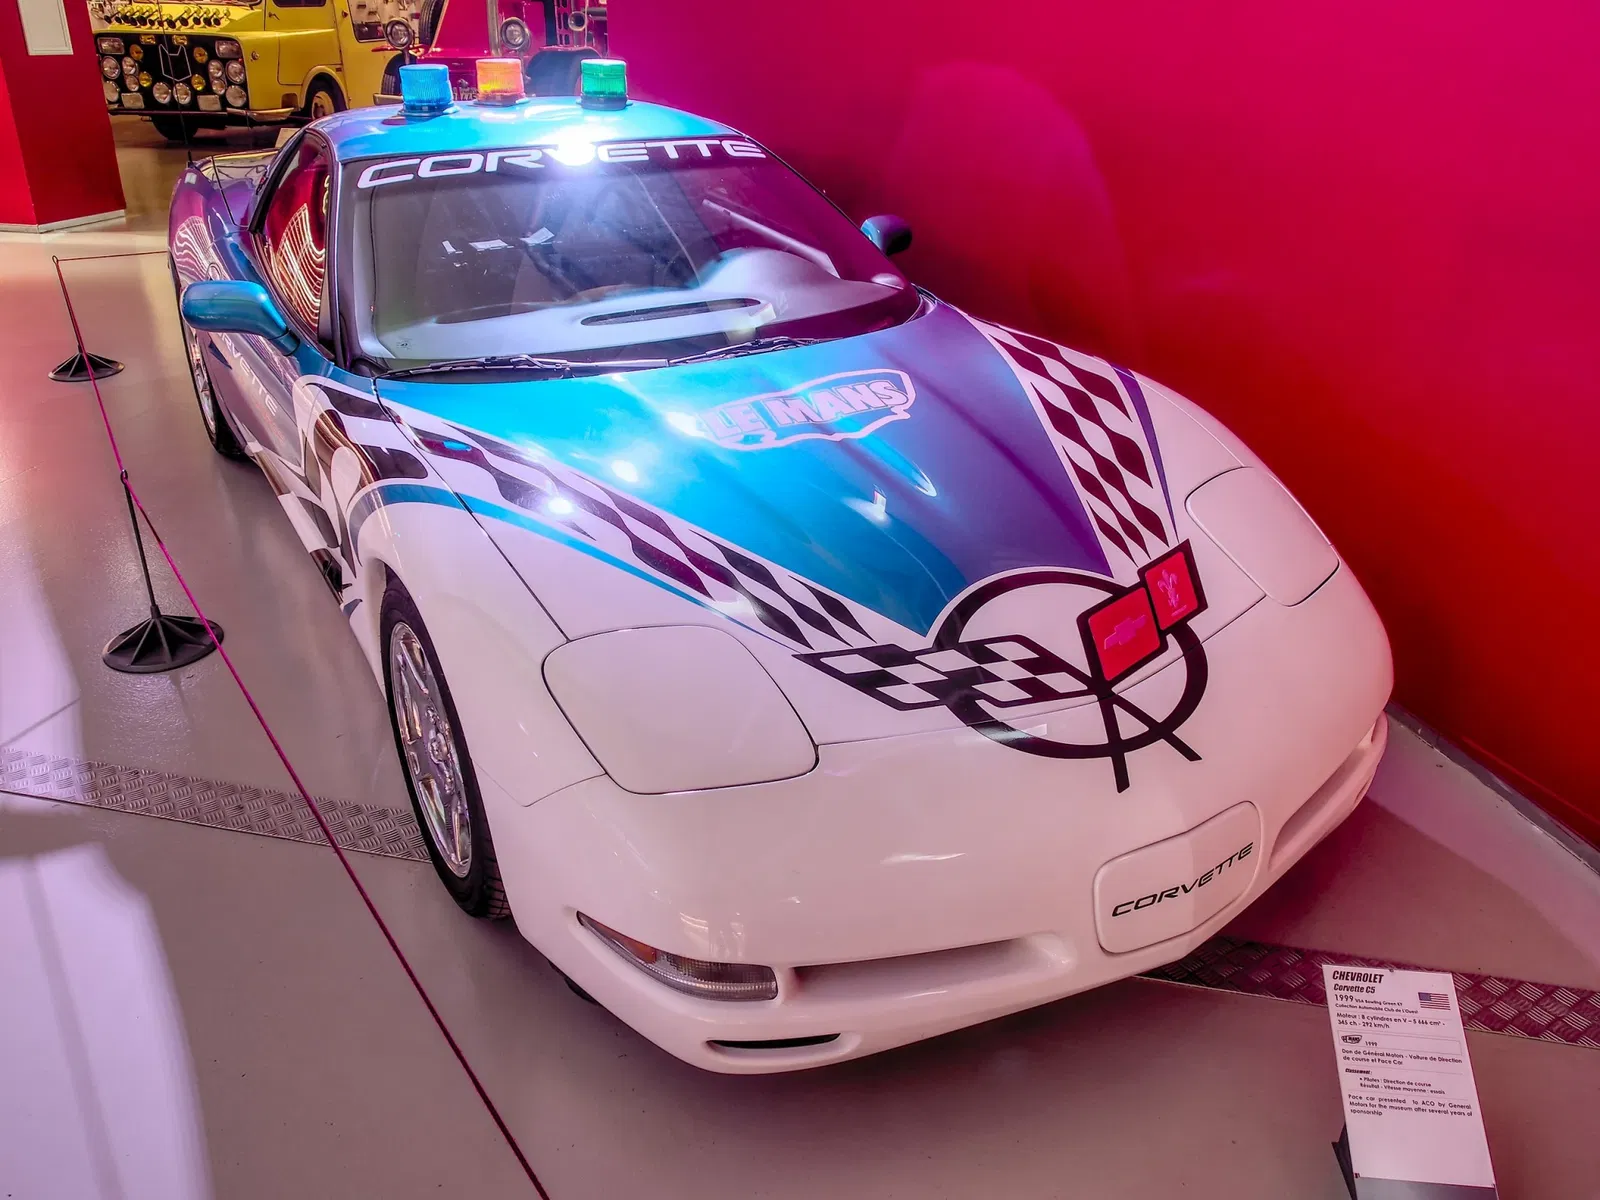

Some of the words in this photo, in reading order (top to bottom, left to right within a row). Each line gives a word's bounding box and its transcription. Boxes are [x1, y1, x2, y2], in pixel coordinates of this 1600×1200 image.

[218, 333, 278, 416] RVETTE
[703, 404, 768, 438] LE
[762, 380, 909, 427] MANS
[1112, 842, 1253, 917] CORVETTE
[1332, 970, 1384, 984] CHEVROLET
[1334, 984, 1364, 993] Corvette
[1366, 985, 1376, 994] C5
[1334, 994, 1354, 1002] 1999
